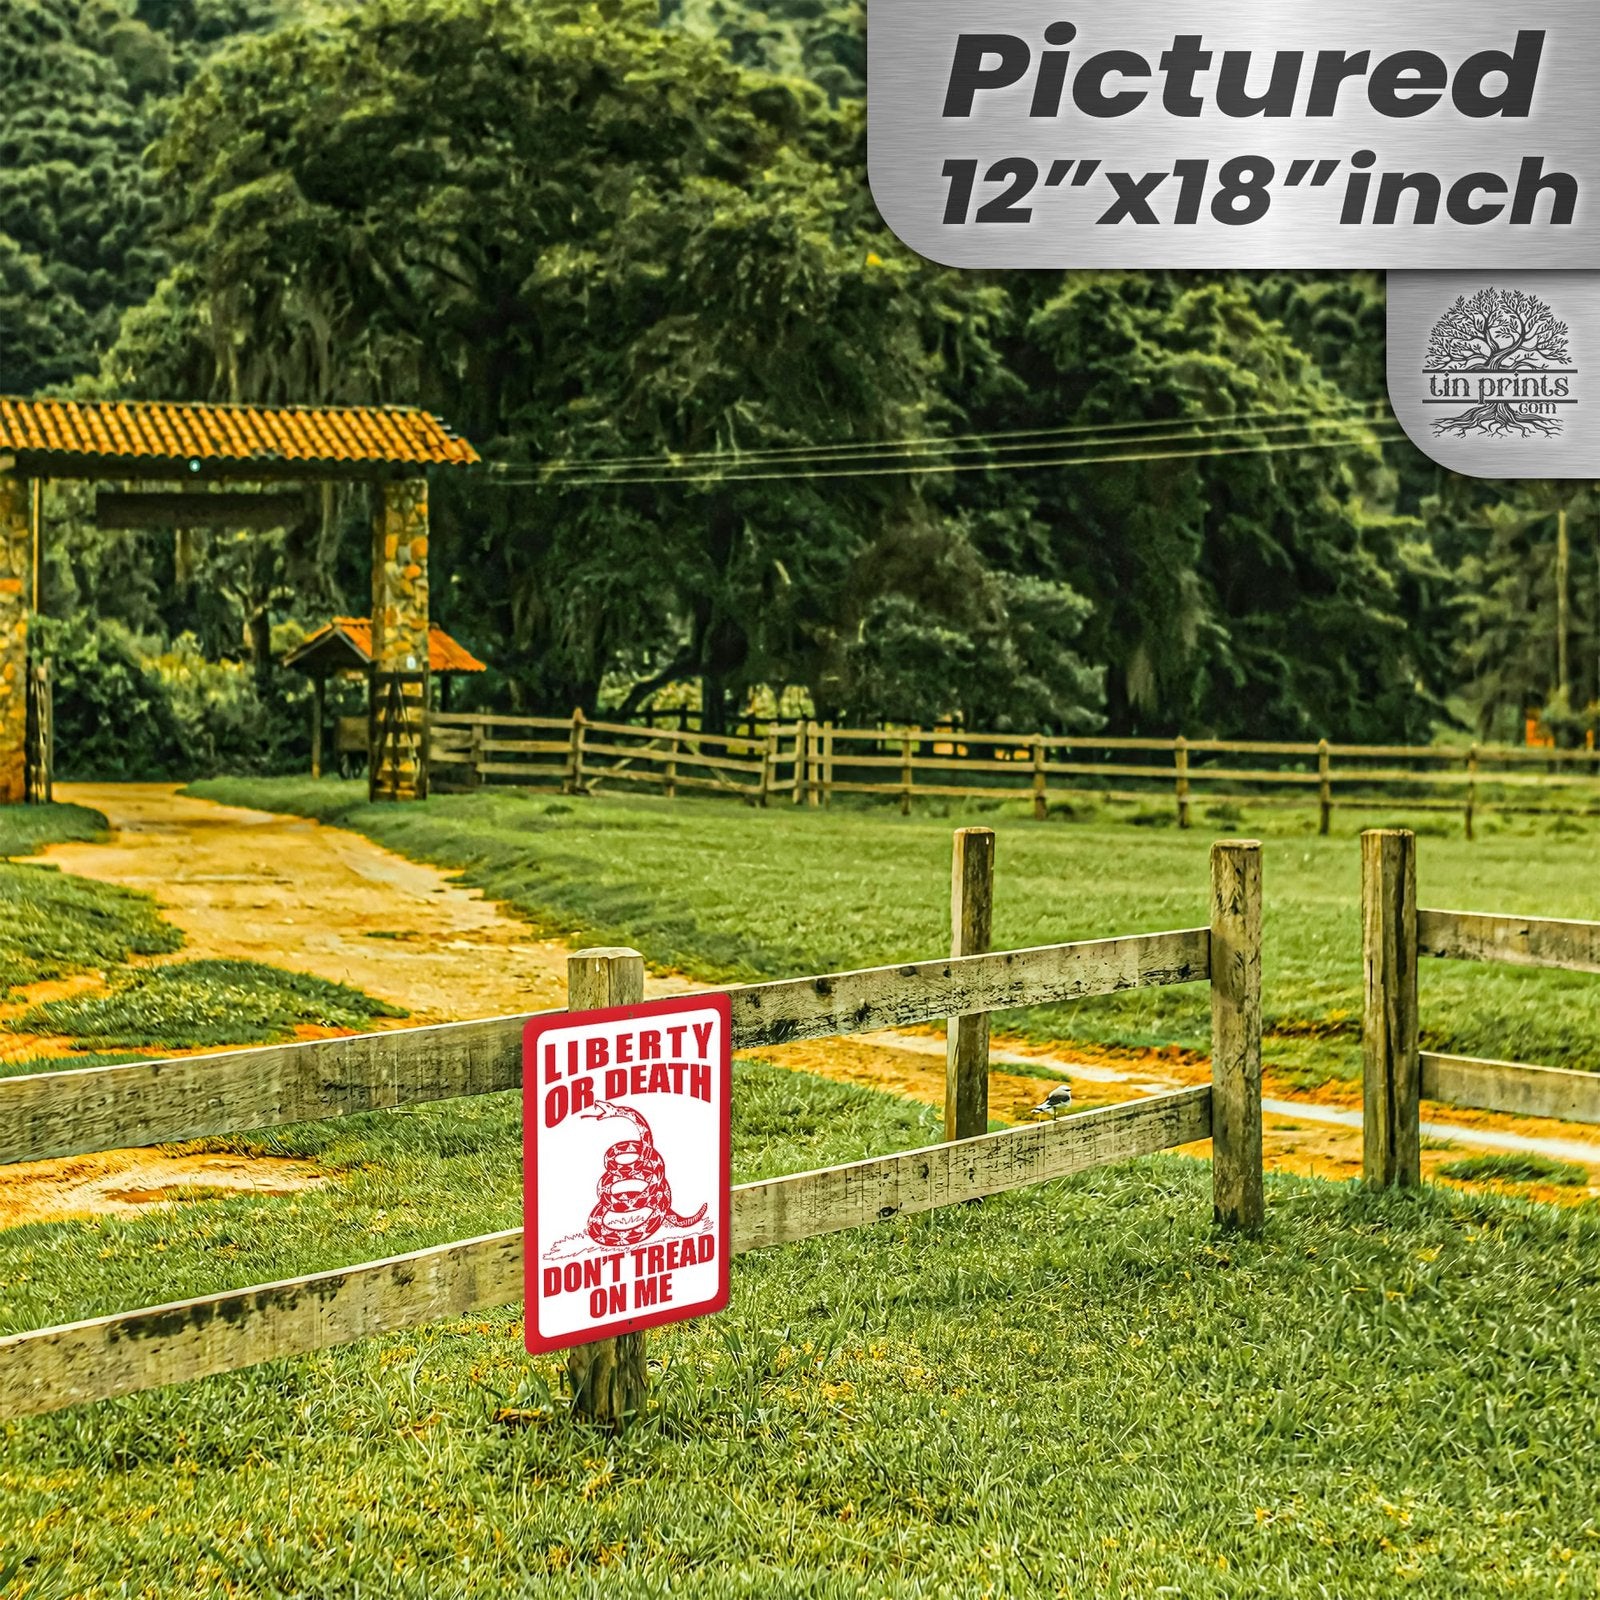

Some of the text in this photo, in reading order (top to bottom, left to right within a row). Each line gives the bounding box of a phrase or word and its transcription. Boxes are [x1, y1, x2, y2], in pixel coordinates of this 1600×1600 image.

[545, 1022, 714, 1085] LIBERTY
[545, 1062, 711, 1129] OR DEATH
[543, 1234, 715, 1298] DON'T TREAD
[590, 1273, 673, 1319] ON ME
